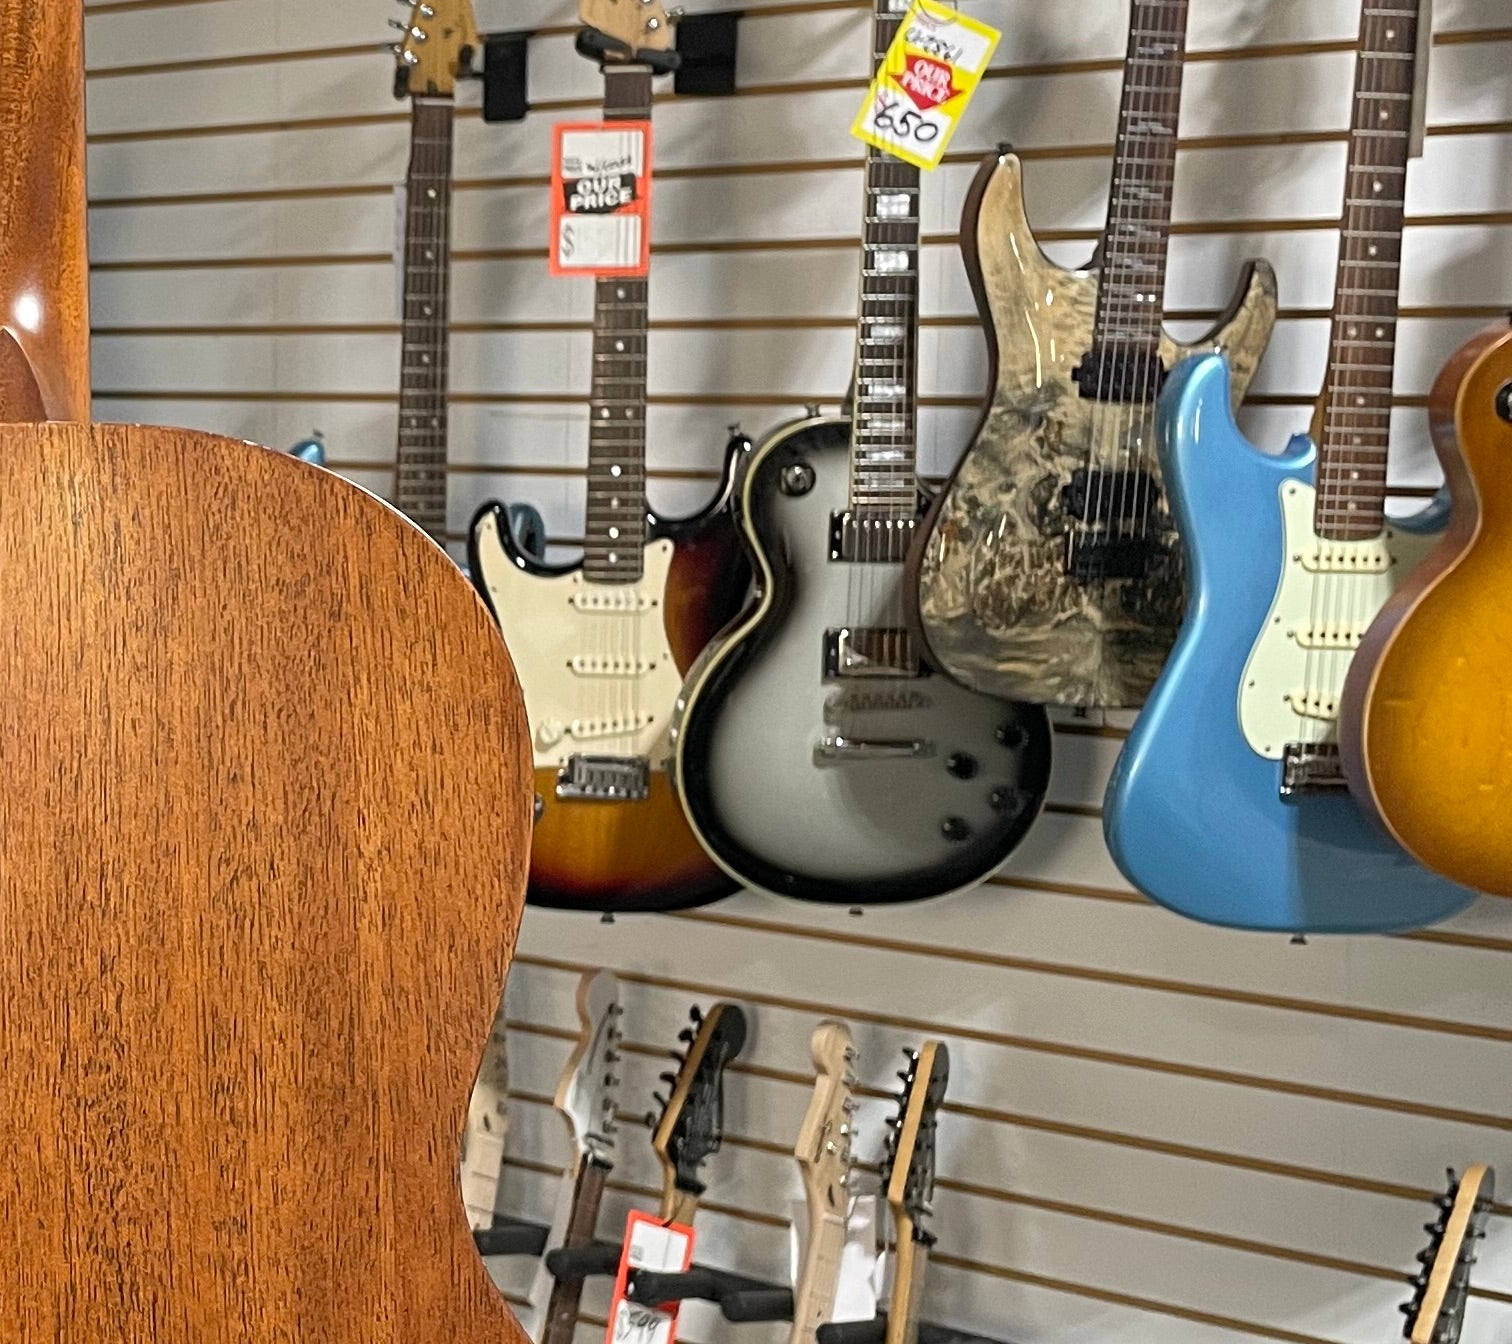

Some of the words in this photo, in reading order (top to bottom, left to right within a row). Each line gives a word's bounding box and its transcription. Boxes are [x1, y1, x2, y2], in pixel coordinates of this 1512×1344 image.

[913, 58, 952, 85] OUR
[901, 69, 952, 104] PRICE
[576, 175, 622, 196] OUR
[569, 186, 633, 212] PRICE
